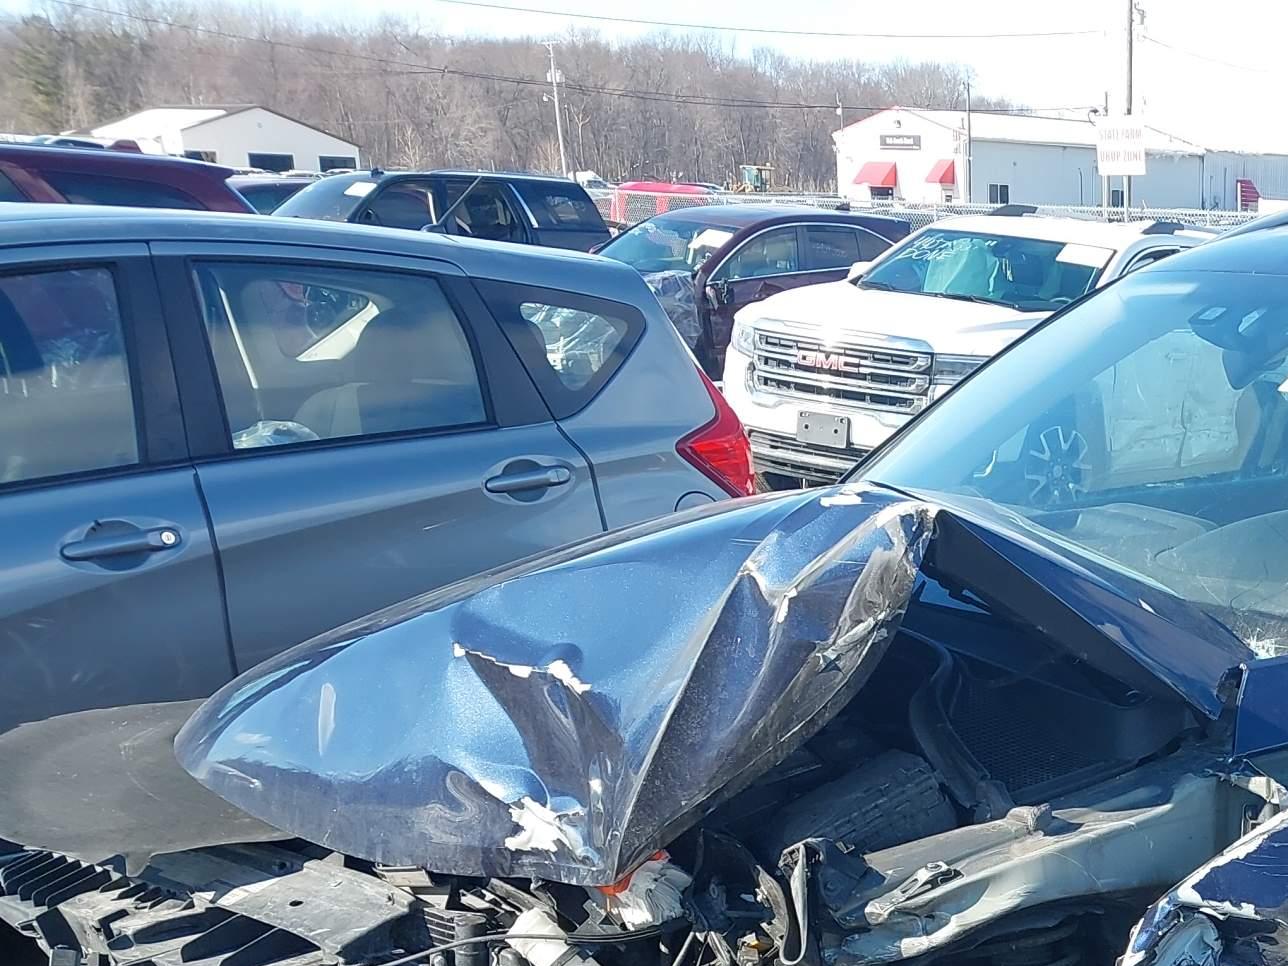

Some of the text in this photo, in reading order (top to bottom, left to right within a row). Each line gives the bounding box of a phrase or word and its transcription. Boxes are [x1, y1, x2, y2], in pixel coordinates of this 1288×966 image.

[1098, 128, 1142, 141] STATE FARM
[797, 350, 860, 373] GMC
